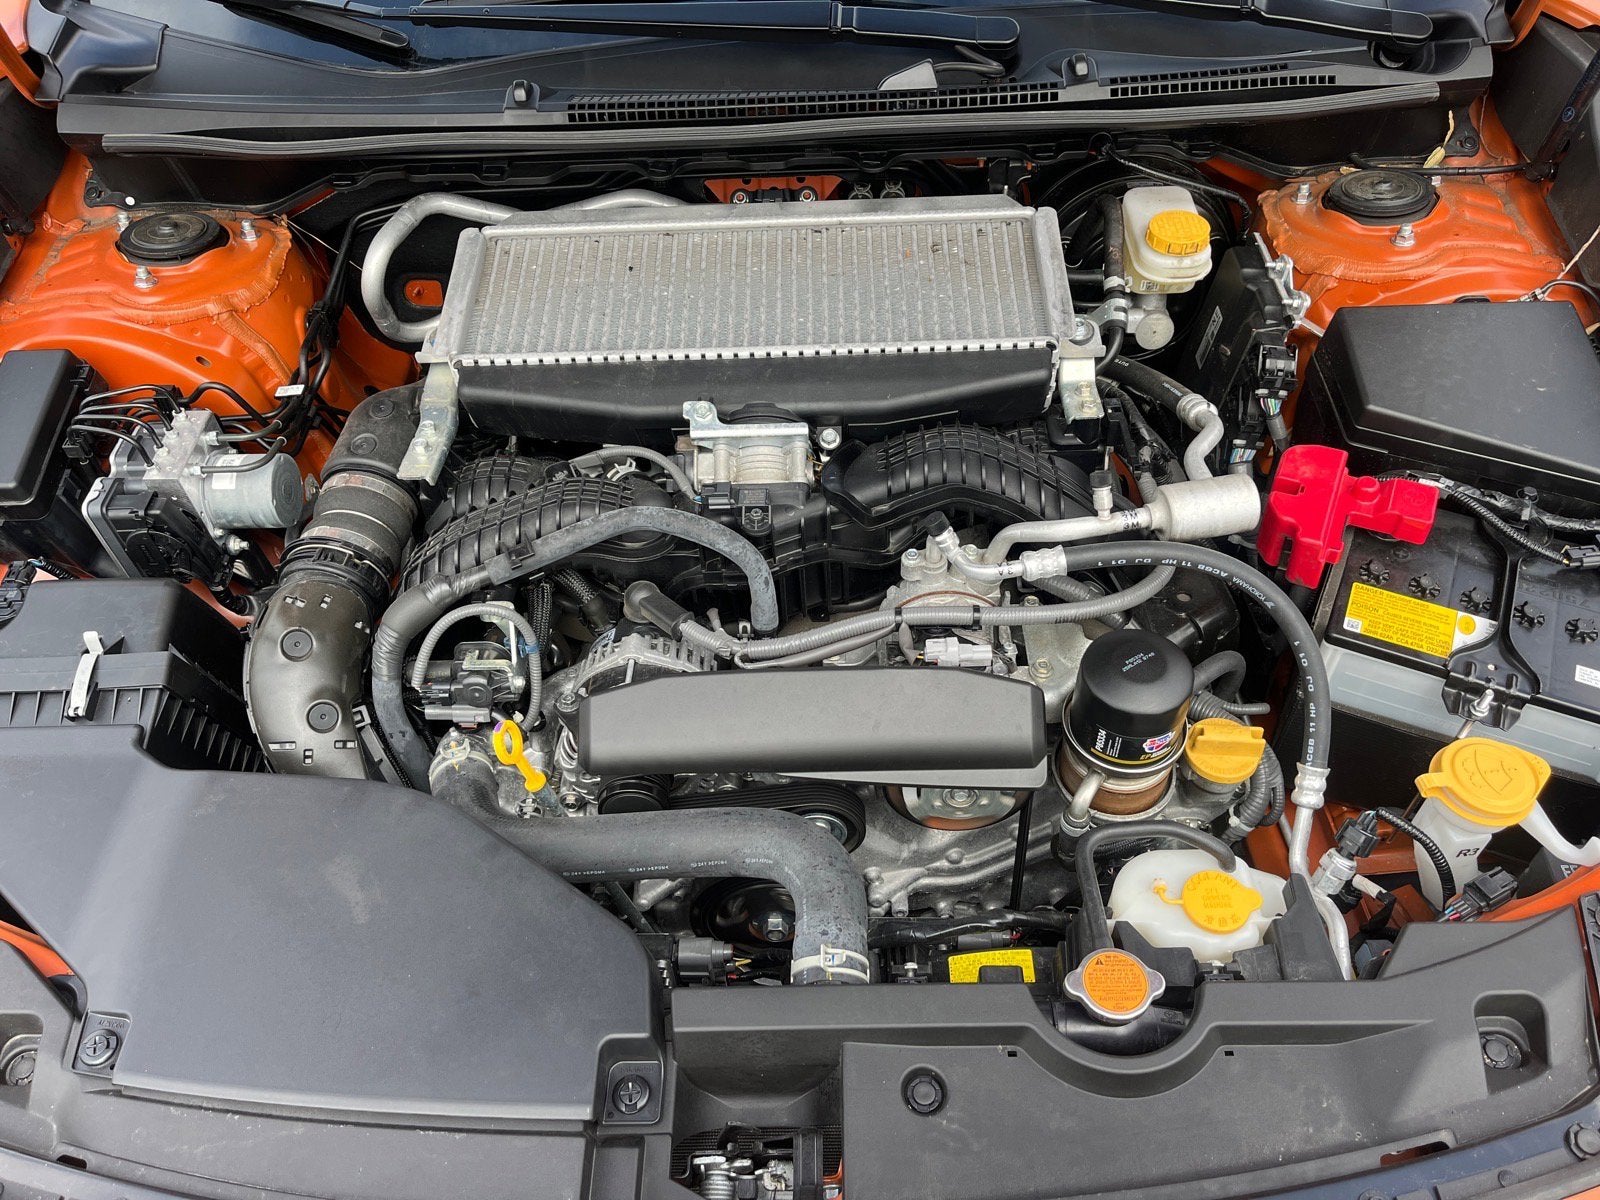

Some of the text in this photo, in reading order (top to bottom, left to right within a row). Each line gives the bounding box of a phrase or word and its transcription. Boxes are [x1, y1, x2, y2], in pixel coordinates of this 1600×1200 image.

[1232, 576, 1267, 600] YOKOHAMA
[1354, 584, 1384, 596] DANGER
[1351, 600, 1379, 613] POISON
[1309, 702, 1316, 717] HP
[1456, 848, 1479, 857] R3
